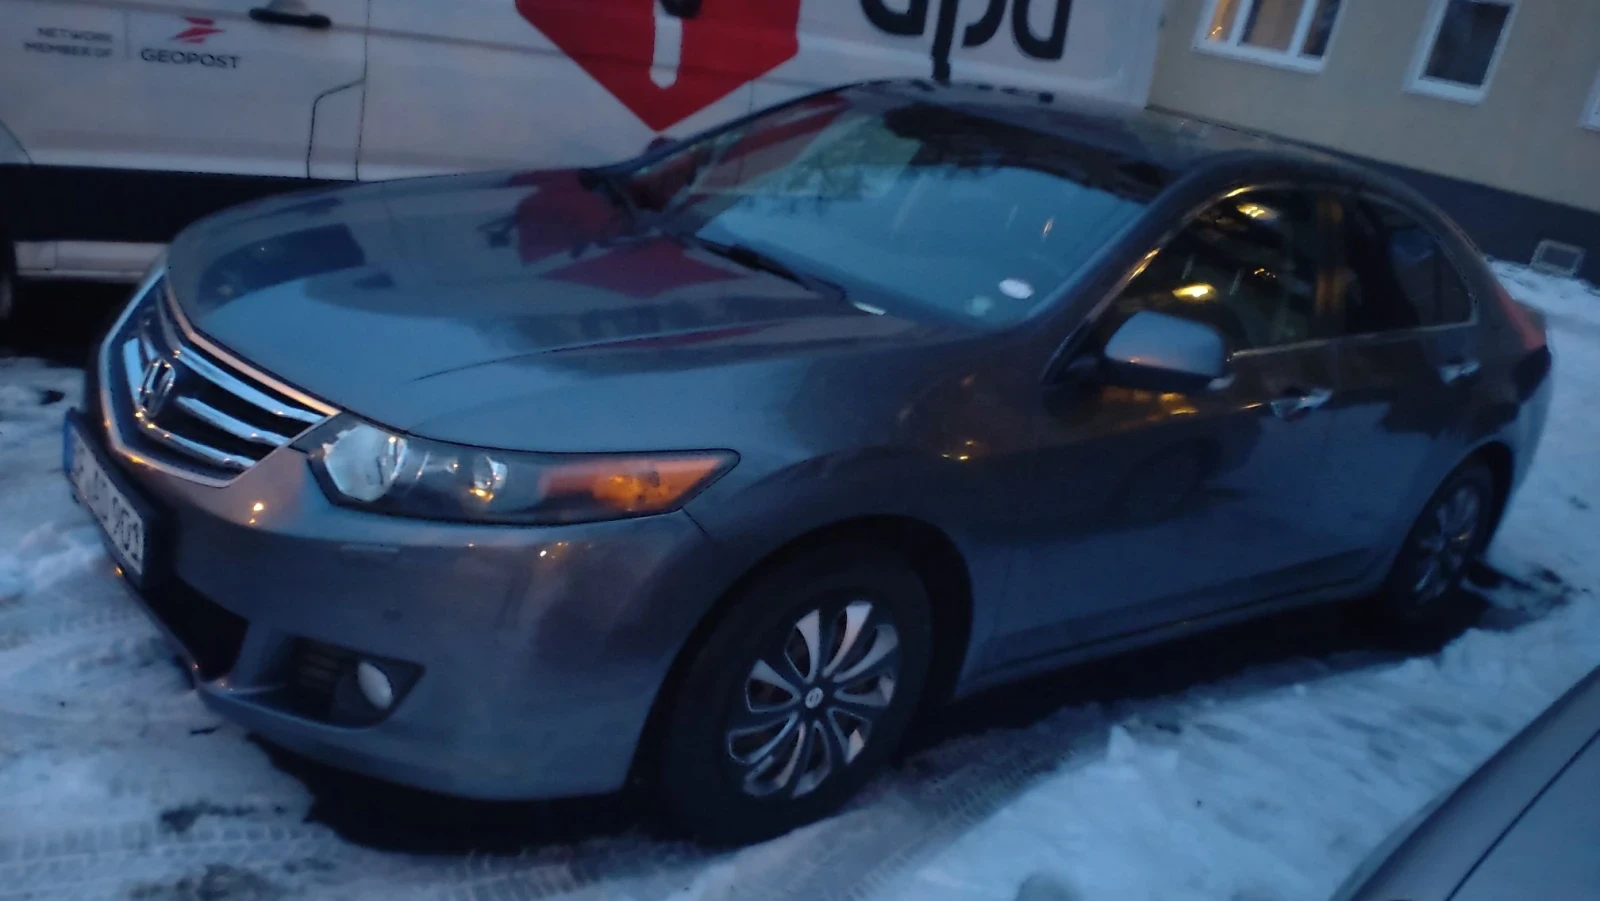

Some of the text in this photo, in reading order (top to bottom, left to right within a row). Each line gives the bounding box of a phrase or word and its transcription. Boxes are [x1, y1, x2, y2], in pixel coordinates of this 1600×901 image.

[37, 27, 113, 43] NETWORK
[24, 42, 91, 57] MEMBER
[140, 48, 242, 69] GEOPOST
